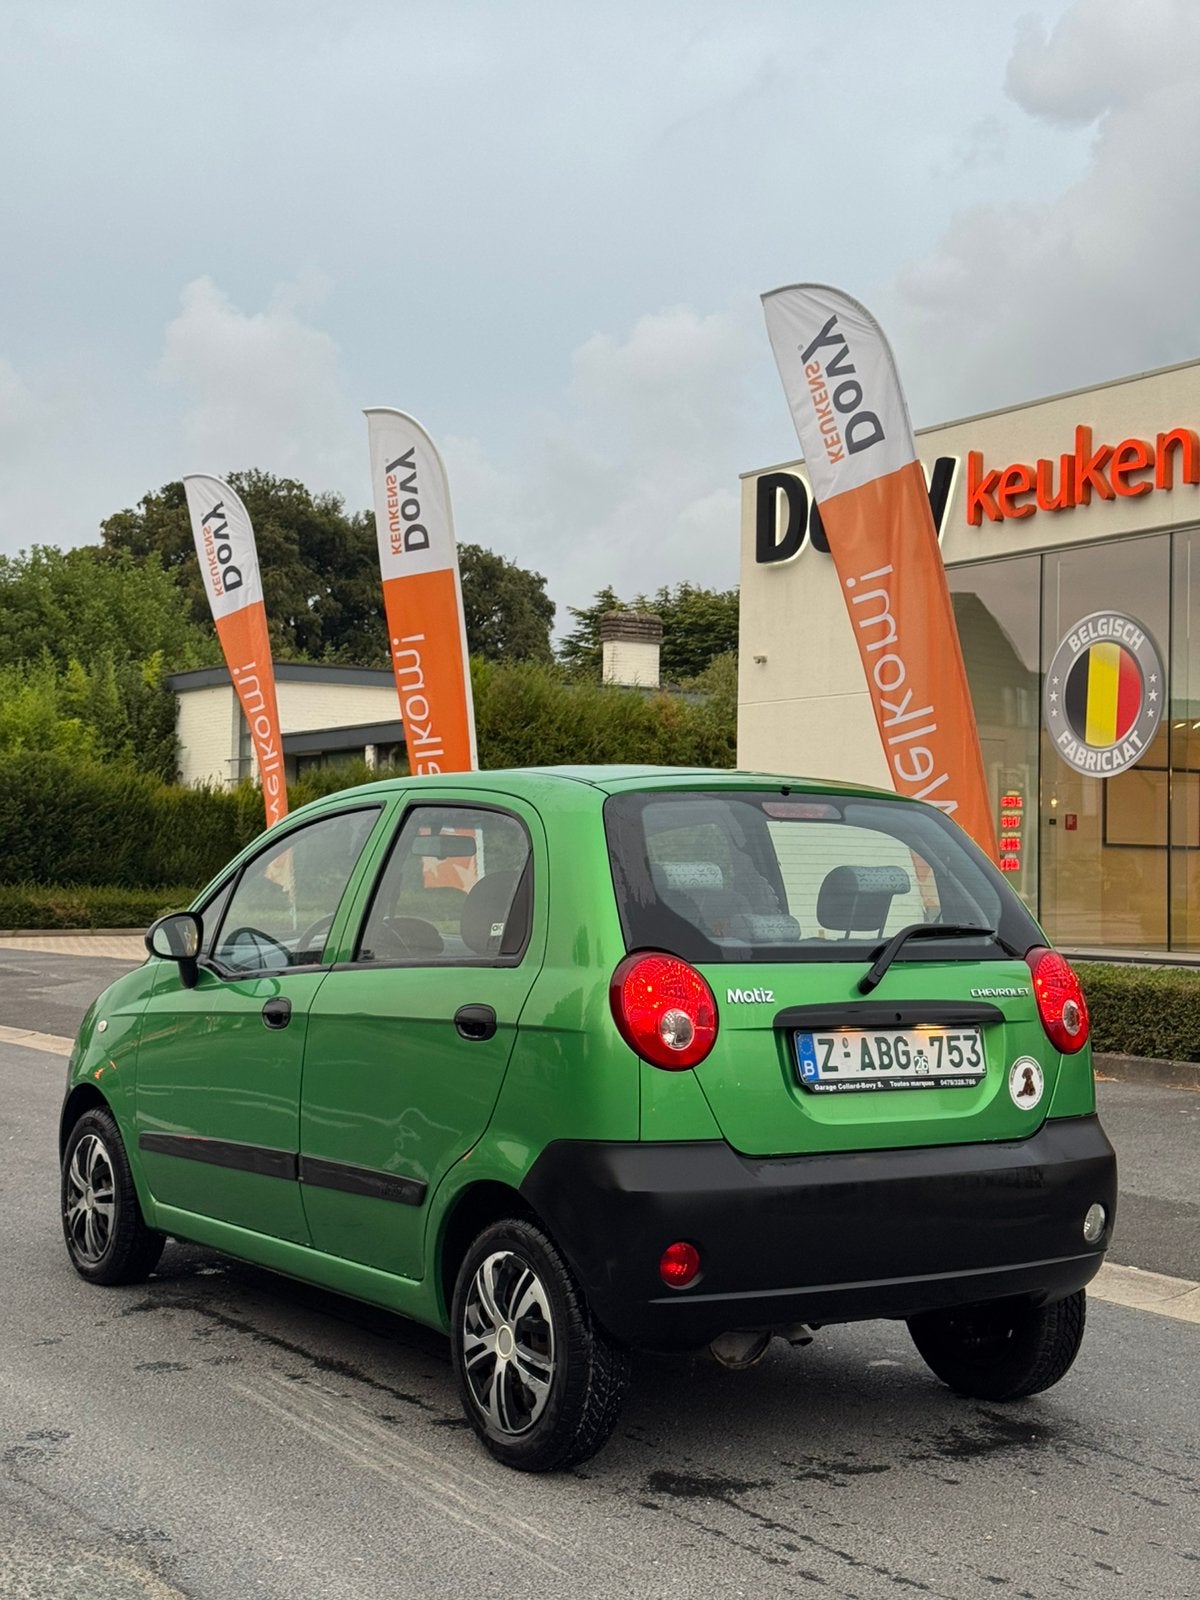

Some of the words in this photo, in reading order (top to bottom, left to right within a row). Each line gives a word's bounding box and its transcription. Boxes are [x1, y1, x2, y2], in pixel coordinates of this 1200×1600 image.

[966, 424, 1199, 526] keuken
[1067, 618, 1146, 653] BELGISCH
[1057, 730, 1144, 771] FABRICAAT
[727, 987, 775, 1003] Matiz
[970, 987, 1030, 998] CHEVROLET
[804, 1060, 816, 1076] B
[814, 1083, 837, 1091] Garage
[890, 1080, 909, 1088] Toutes
[910, 1079, 935, 1088] marques
